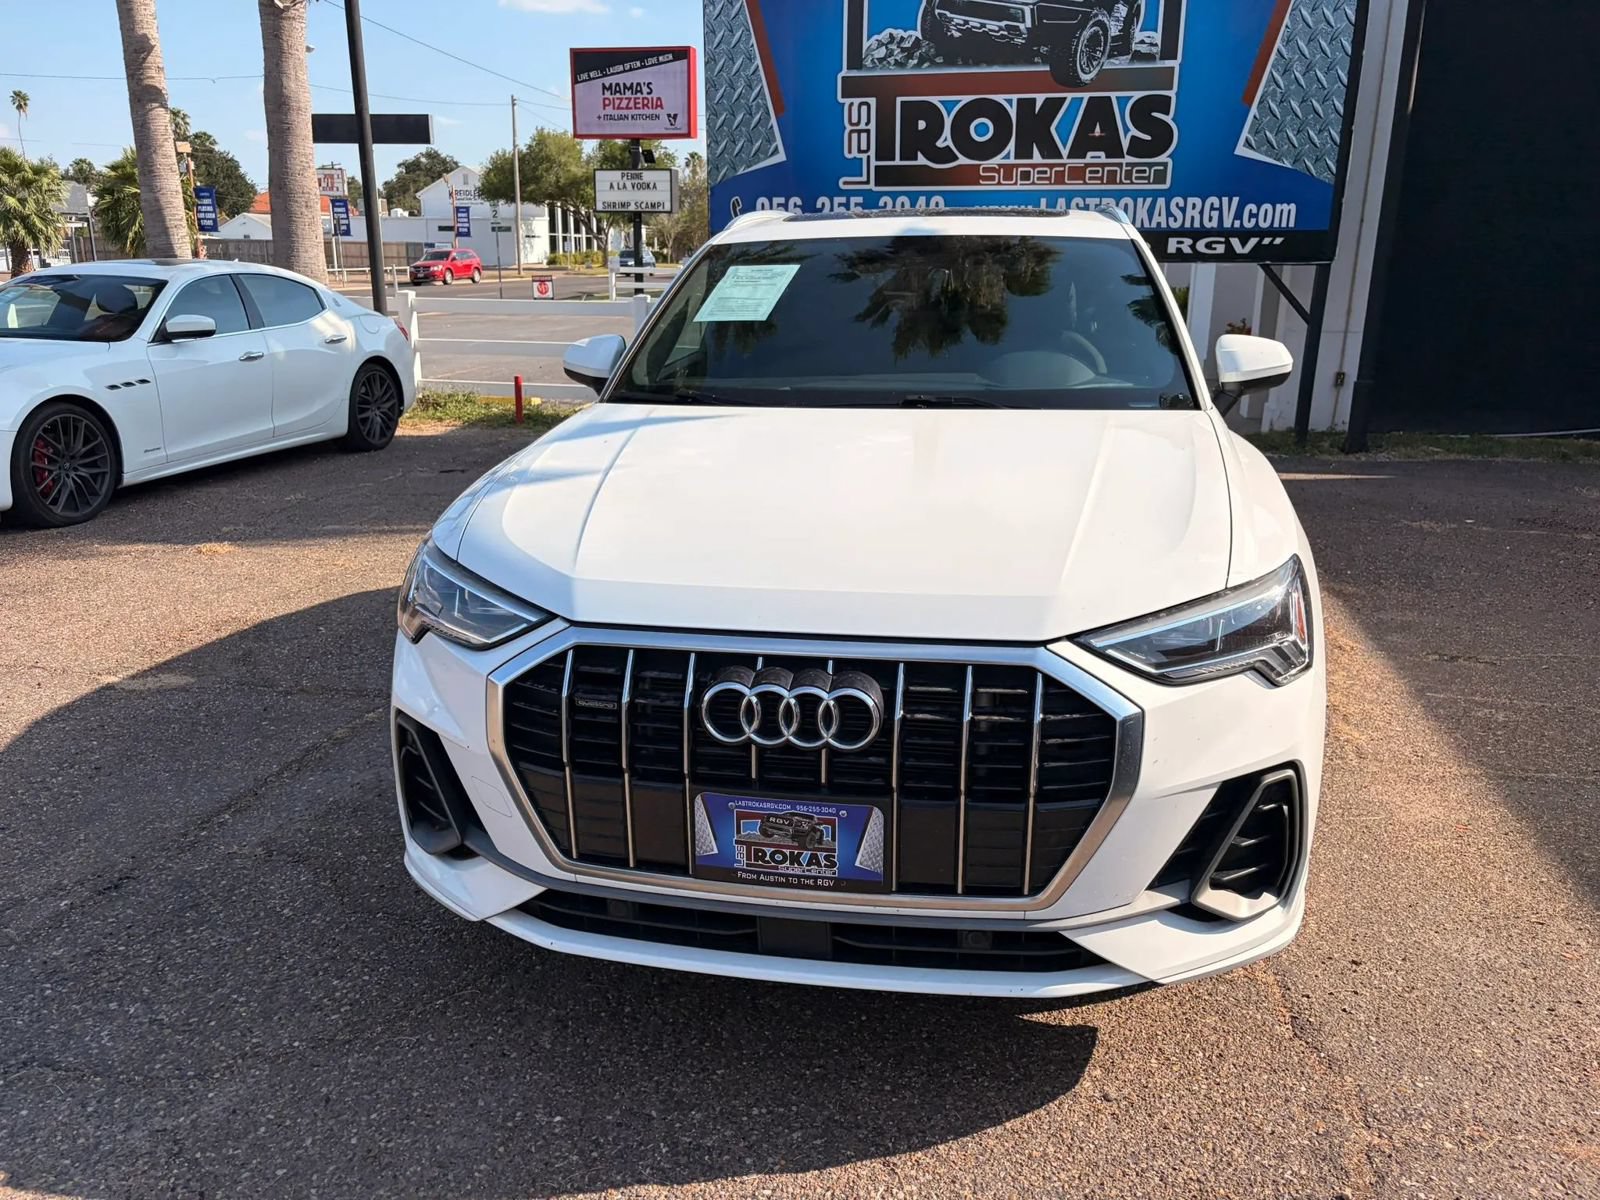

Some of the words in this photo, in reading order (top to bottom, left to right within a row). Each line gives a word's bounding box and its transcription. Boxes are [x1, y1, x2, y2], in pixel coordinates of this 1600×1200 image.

[577, 71, 590, 81] LIVE
[589, 70, 603, 78] WELL
[606, 64, 624, 74] LAUGH
[624, 60, 640, 70] OFTEN
[644, 56, 659, 66] LOVE
[601, 82, 653, 96] MAMA'S
[602, 97, 664, 111] PIZZERIA
[603, 113, 629, 121] ITALIAN
[631, 113, 660, 121] KITCHEN
[850, 84, 1178, 167] TROKAS
[621, 172, 644, 180] PENNE
[978, 163, 1166, 186] SuperCenter
[631, 182, 657, 190] VODKA
[602, 201, 631, 209] SHRIMP
[634, 201, 665, 209] SCAMPI
[492, 210, 498, 218] 2
[735, 800, 791, 810] LASTROKASRGV.COM
[796, 805, 837, 814] 956-255-3040
[769, 816, 790, 825] RGV
[740, 844, 839, 870] TROKAS
[817, 879, 835, 887] RGV
